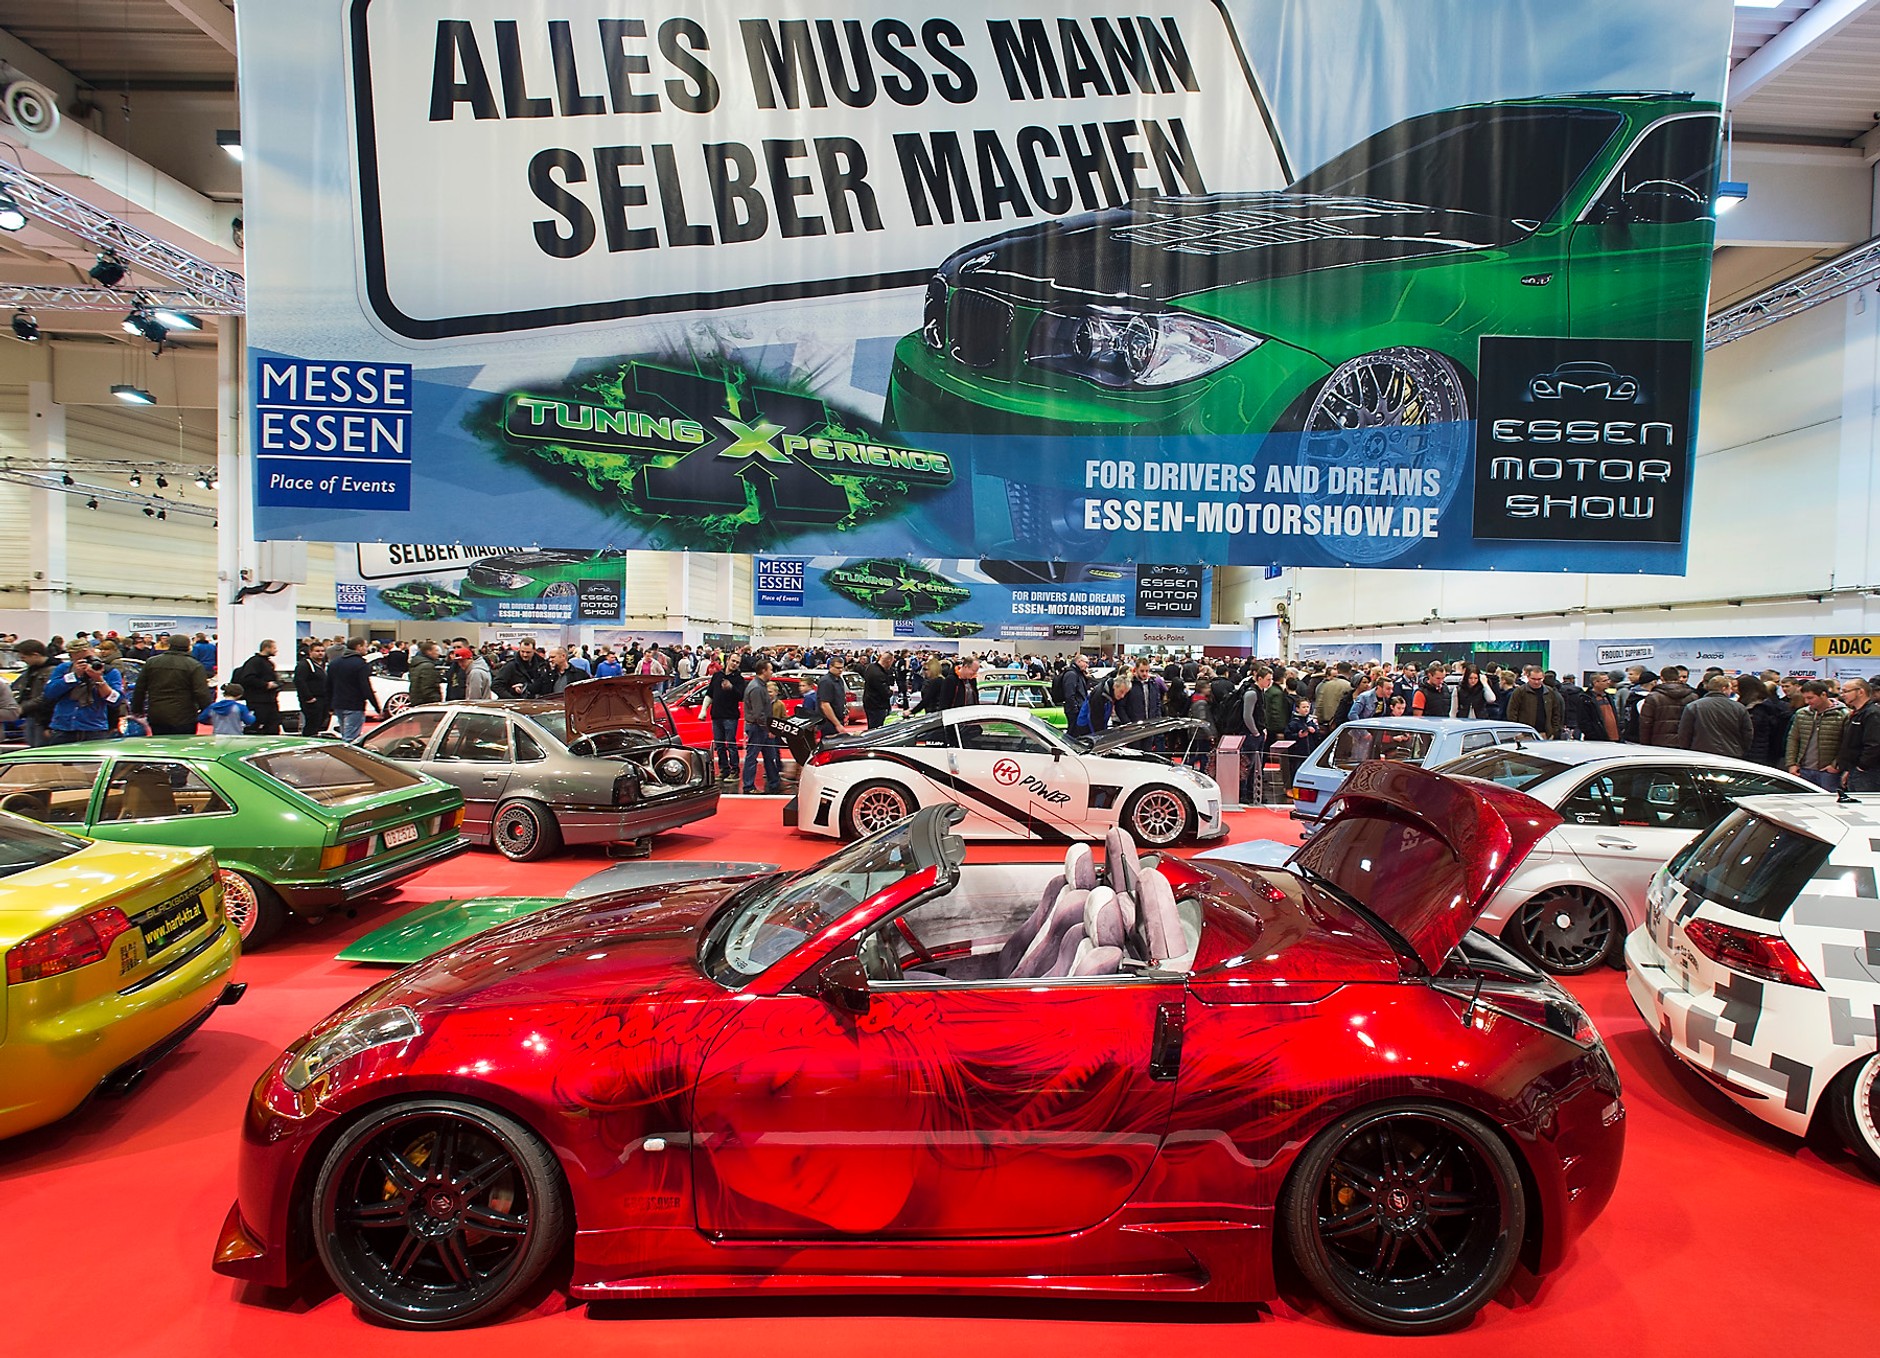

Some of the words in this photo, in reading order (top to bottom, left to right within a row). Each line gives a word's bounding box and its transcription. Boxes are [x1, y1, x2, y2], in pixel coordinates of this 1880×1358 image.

[428, 18, 720, 121] ALLES
[738, 17, 978, 109] MUSS
[986, 16, 1200, 101] MANN
[528, 135, 884, 259] SELBER
[892, 118, 1207, 227] MACHEN
[263, 363, 405, 404] MESSE
[517, 398, 704, 444] TUNING
[262, 413, 404, 454] ESSEN
[1492, 419, 1673, 446] ESSEN
[1085, 460, 1135, 489] FOR
[1144, 462, 1256, 493] DRIVERS
[1264, 465, 1320, 494] AND
[1328, 466, 1441, 497] DREAMS
[1490, 456, 1672, 483] MOTOR
[270, 473, 313, 490] Place
[319, 476, 339, 494] of
[341, 477, 396, 493] Events
[1506, 494, 1655, 520] SHOW
[1083, 498, 1440, 538] ESSEN-MOTORSHOW.DE
[388, 543, 459, 565] SELBER
[760, 561, 802, 574] MESSE
[337, 585, 366, 593] MESSE
[760, 576, 802, 589] ESSEN
[1140, 578, 1198, 589] ESSEN
[337, 594, 366, 603] ESSEN
[581, 594, 618, 602] ESSEN
[1012, 591, 1029, 601] FOR
[1031, 591, 1067, 602] DRIVERS
[1069, 592, 1087, 603] AND
[1089, 593, 1126, 604] DREAMS
[1140, 590, 1198, 600] MOTOR
[584, 608, 615, 616] SHOW
[1011, 603, 1126, 617] ESSEN-MOTORSHOW.DE
[1145, 602, 1192, 611] SHOW
[1143, 633, 1185, 641] Snack-Point
[1827, 638, 1872, 655] ADAC
[1019, 775, 1071, 808] POWER
